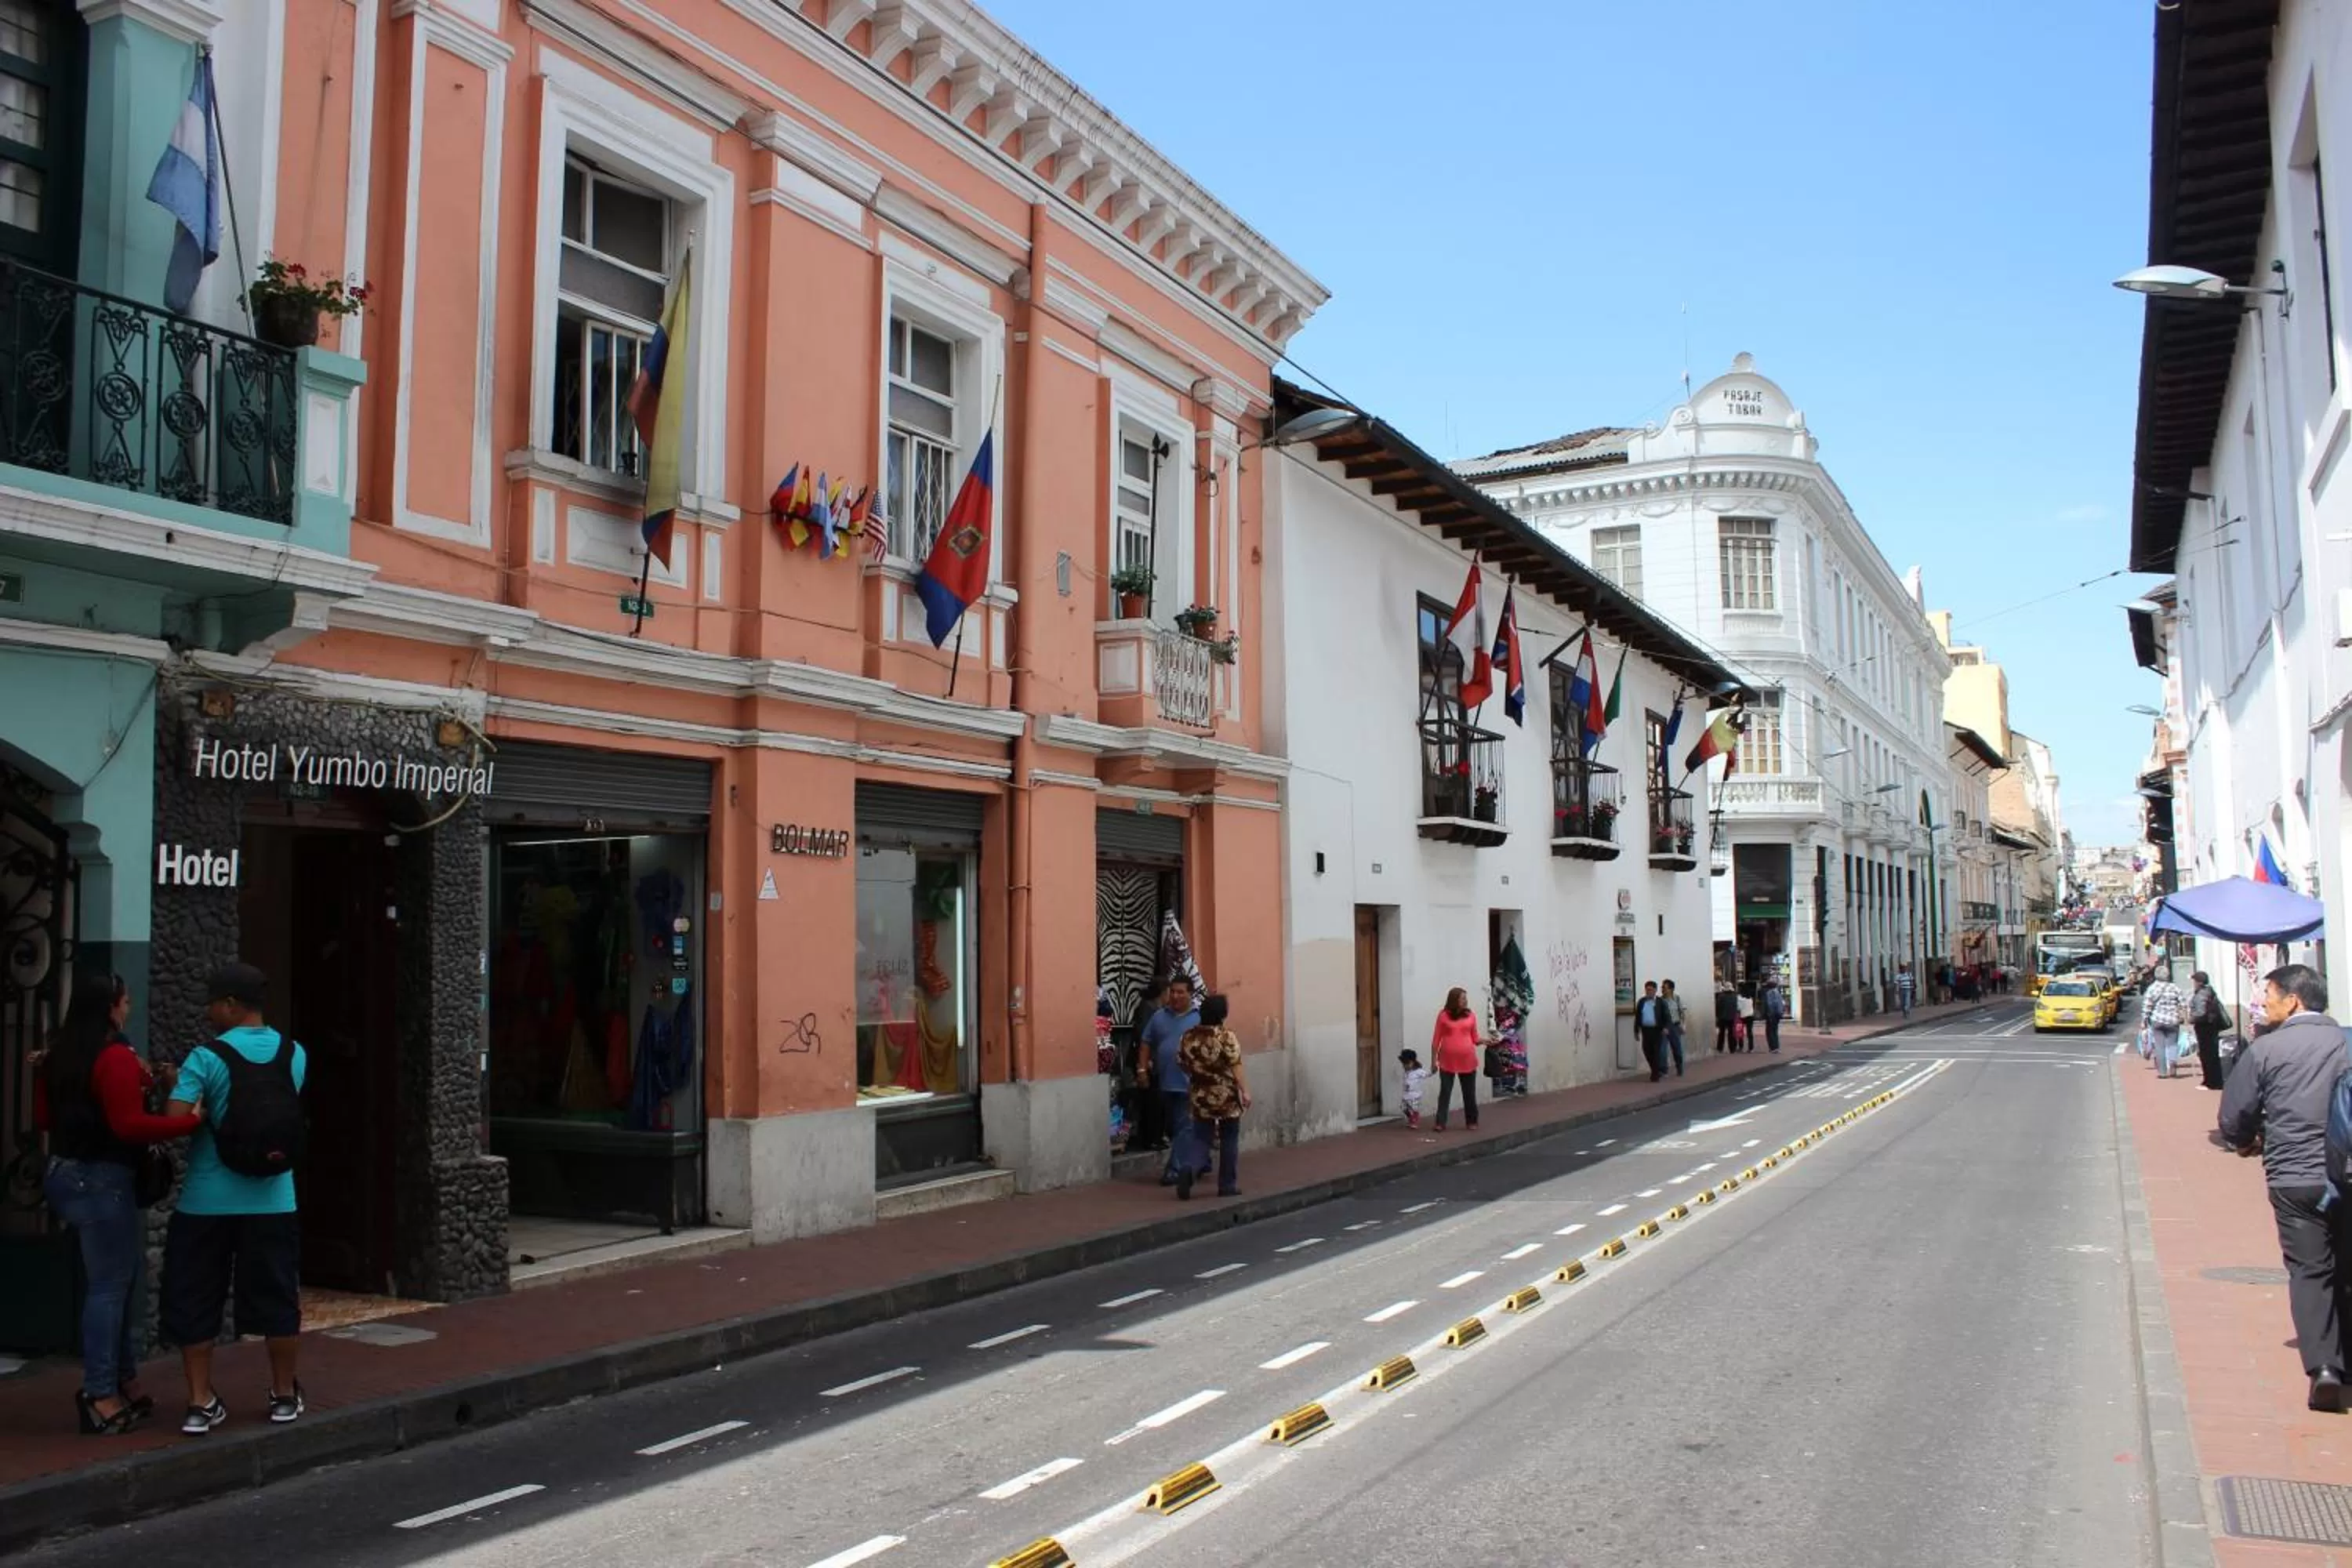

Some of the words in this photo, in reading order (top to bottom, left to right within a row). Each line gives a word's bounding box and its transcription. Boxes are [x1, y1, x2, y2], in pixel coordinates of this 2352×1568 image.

[1723, 389, 1762, 402] PASAJE
[195, 738, 277, 782] Hotel
[289, 744, 387, 789] Yumbo
[394, 753, 495, 801] Imperial
[770, 822, 849, 857] BOLMAR
[158, 843, 239, 887] Hotel
